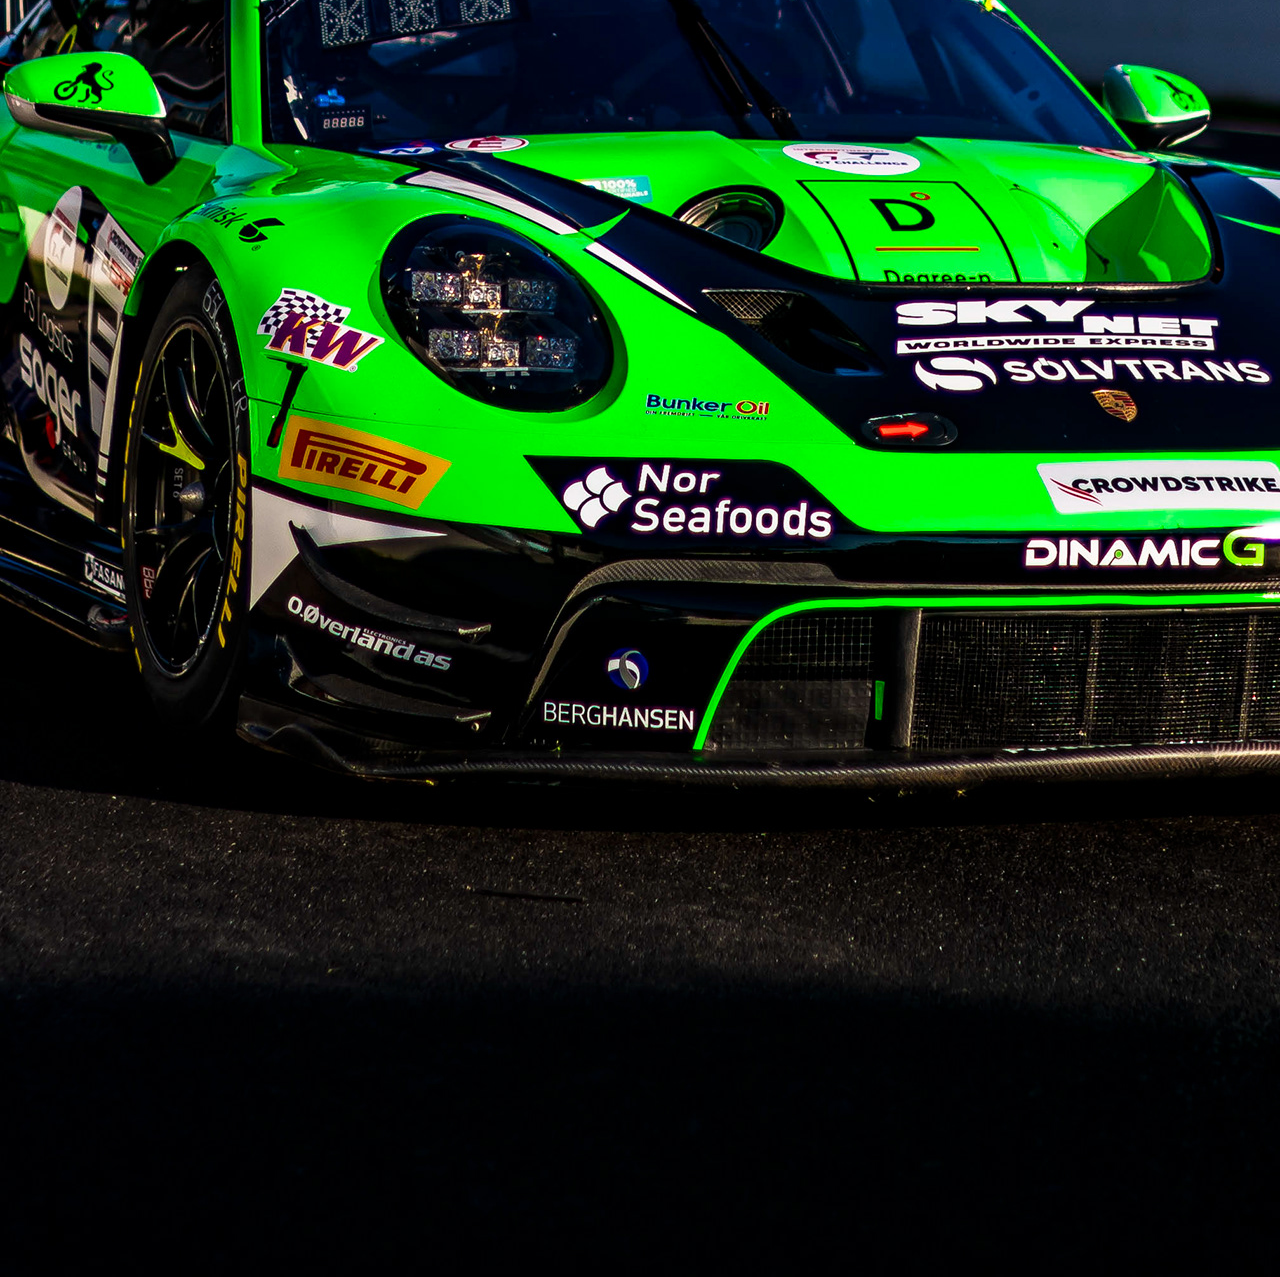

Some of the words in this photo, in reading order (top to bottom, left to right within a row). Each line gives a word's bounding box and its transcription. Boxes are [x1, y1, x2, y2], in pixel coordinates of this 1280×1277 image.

[268, 310, 381, 367] KW
[904, 337, 1076, 351] WORLDWIDE
[1089, 337, 1209, 348] EXPRESS
[646, 394, 733, 413] Bunker
[735, 400, 769, 415] Oil
[290, 428, 428, 495] PIRELLI
[174, 467, 184, 487] SET
[637, 464, 721, 494] Nor
[630, 497, 832, 539] Seafoods
[217, 453, 248, 649] PIRELLI
[362, 627, 408, 646] ELECTRONICS
[413, 649, 453, 671] as
[543, 700, 695, 731] BERGHANSEN
